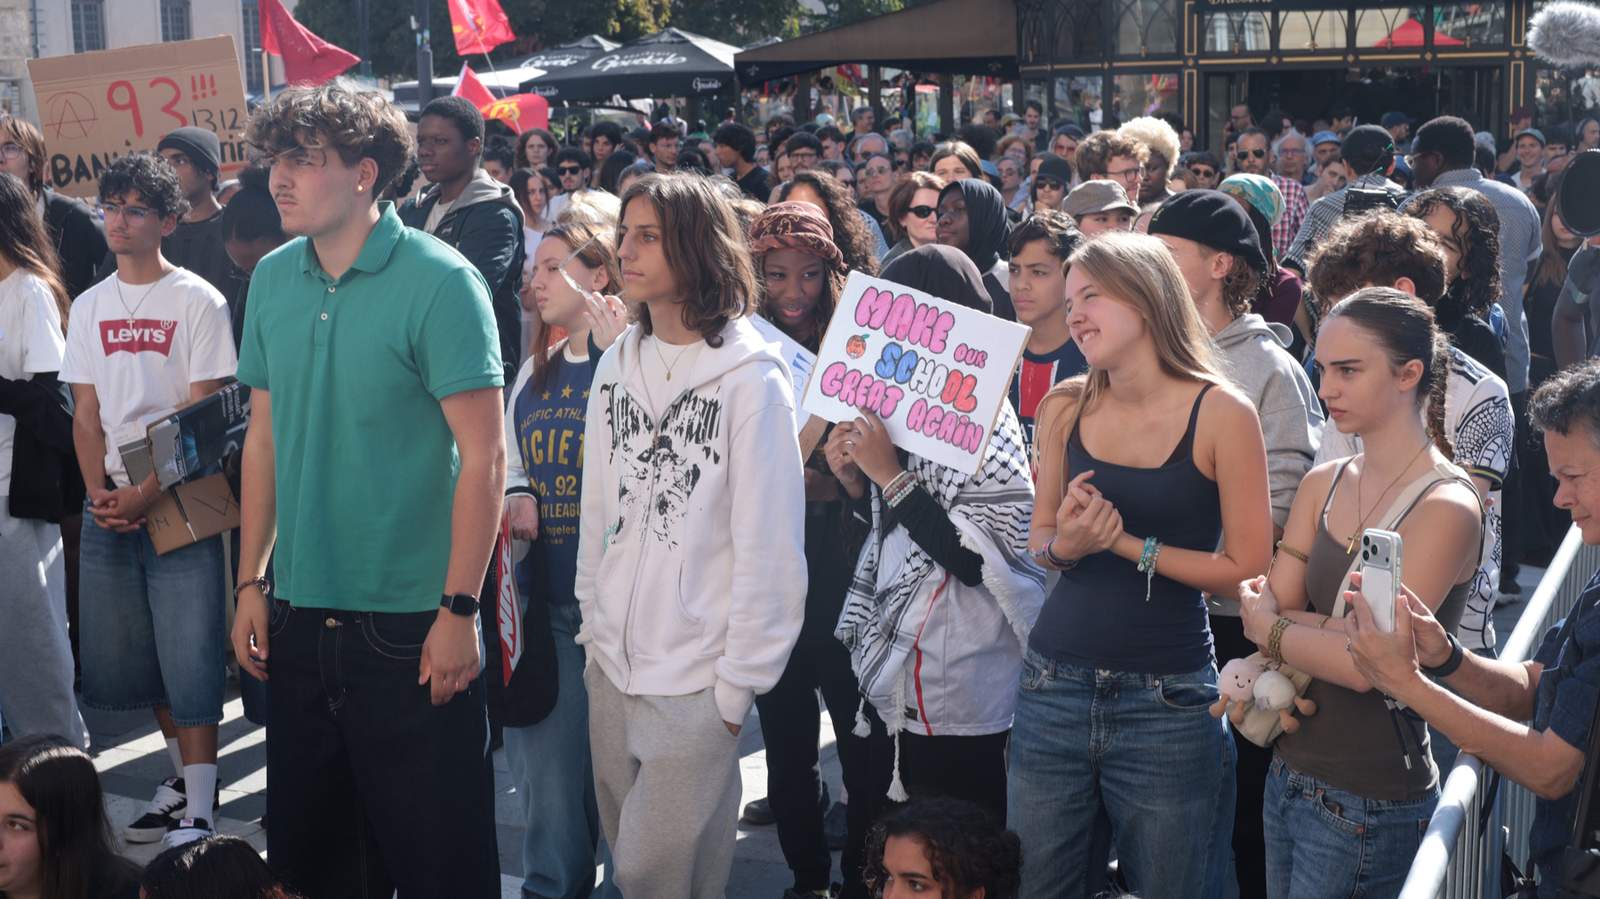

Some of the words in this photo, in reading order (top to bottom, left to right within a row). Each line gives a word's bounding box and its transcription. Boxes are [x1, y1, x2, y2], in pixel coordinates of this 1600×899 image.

[192, 108, 242, 132] 1312
[855, 287, 955, 354] MAKE
[954, 343, 988, 368] OUR
[820, 361, 904, 419] GREAT
[875, 342, 977, 413] SCHOOL
[555, 475, 577, 496] 92
